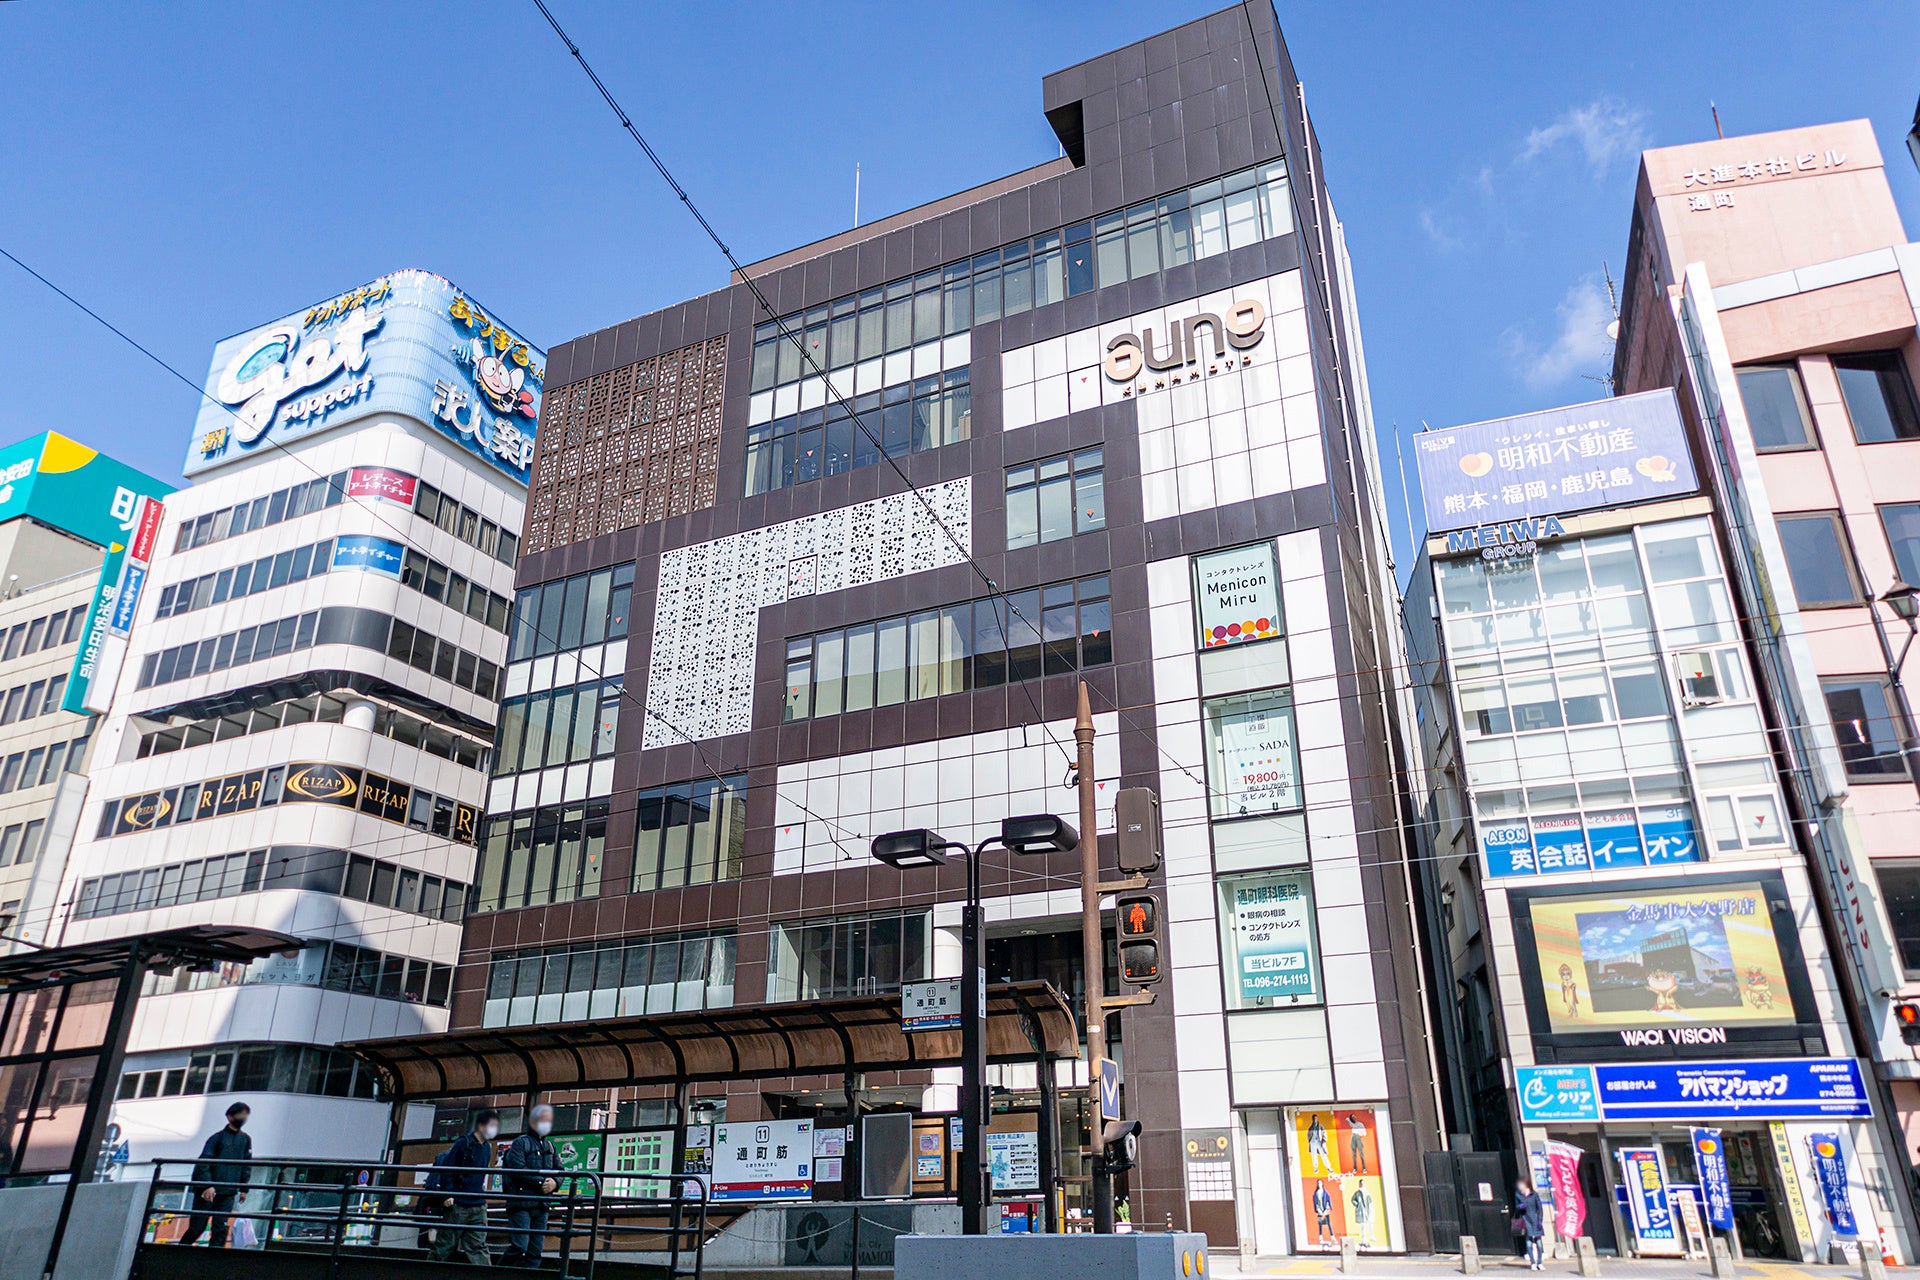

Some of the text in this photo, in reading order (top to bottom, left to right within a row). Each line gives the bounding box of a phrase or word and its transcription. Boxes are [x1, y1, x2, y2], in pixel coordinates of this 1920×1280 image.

[1684, 150, 1847, 187] 大進本社ビル
[1689, 191, 1736, 212] 通町
[1105, 299, 1265, 382] aune
[1123, 356, 1252, 397] KUMAMOTO
[281, 373, 372, 421] support
[1498, 427, 1637, 472] 明和不動産
[350, 482, 413, 497] アートネイチャー
[363, 474, 403, 486] レディース
[1444, 467, 1634, 514] 熊本・福岡・鹿児島
[1447, 515, 1567, 553] MEIWA
[337, 546, 400, 561] アートネイチャー
[1482, 541, 1537, 561] GROUP
[1206, 561, 1265, 578] コンタクトレンズ
[1208, 575, 1267, 595] Menicon
[1220, 594, 1257, 609] Miru
[1259, 739, 1289, 752] SADA
[302, 777, 342, 788] RIZAP
[201, 780, 261, 808] RIZAP
[364, 785, 408, 810] RIZAP
[1559, 818, 1580, 827] KIDS
[1487, 828, 1528, 846] AEON
[1510, 836, 1694, 871] 英会話イーオン
[1237, 884, 1299, 905] 通町眼科医院
[1247, 909, 1287, 919] 眼病の相談
[1627, 898, 1756, 921] 金馬車大矢野店
[1249, 920, 1301, 931] コンタクトレンズ
[1249, 933, 1271, 941] の処方
[916, 997, 947, 1007] 通町筋
[1621, 1027, 1727, 1046] WAO! VISION
[1678, 1074, 1788, 1097] アパマンショップ
[1557, 1091, 1592, 1104] クリア
[757, 1129, 768, 1140] 11
[736, 1145, 788, 1161] 通町筋
[1703, 1154, 1725, 1221] 明和不動産
[1643, 1229, 1672, 1239] AEON
